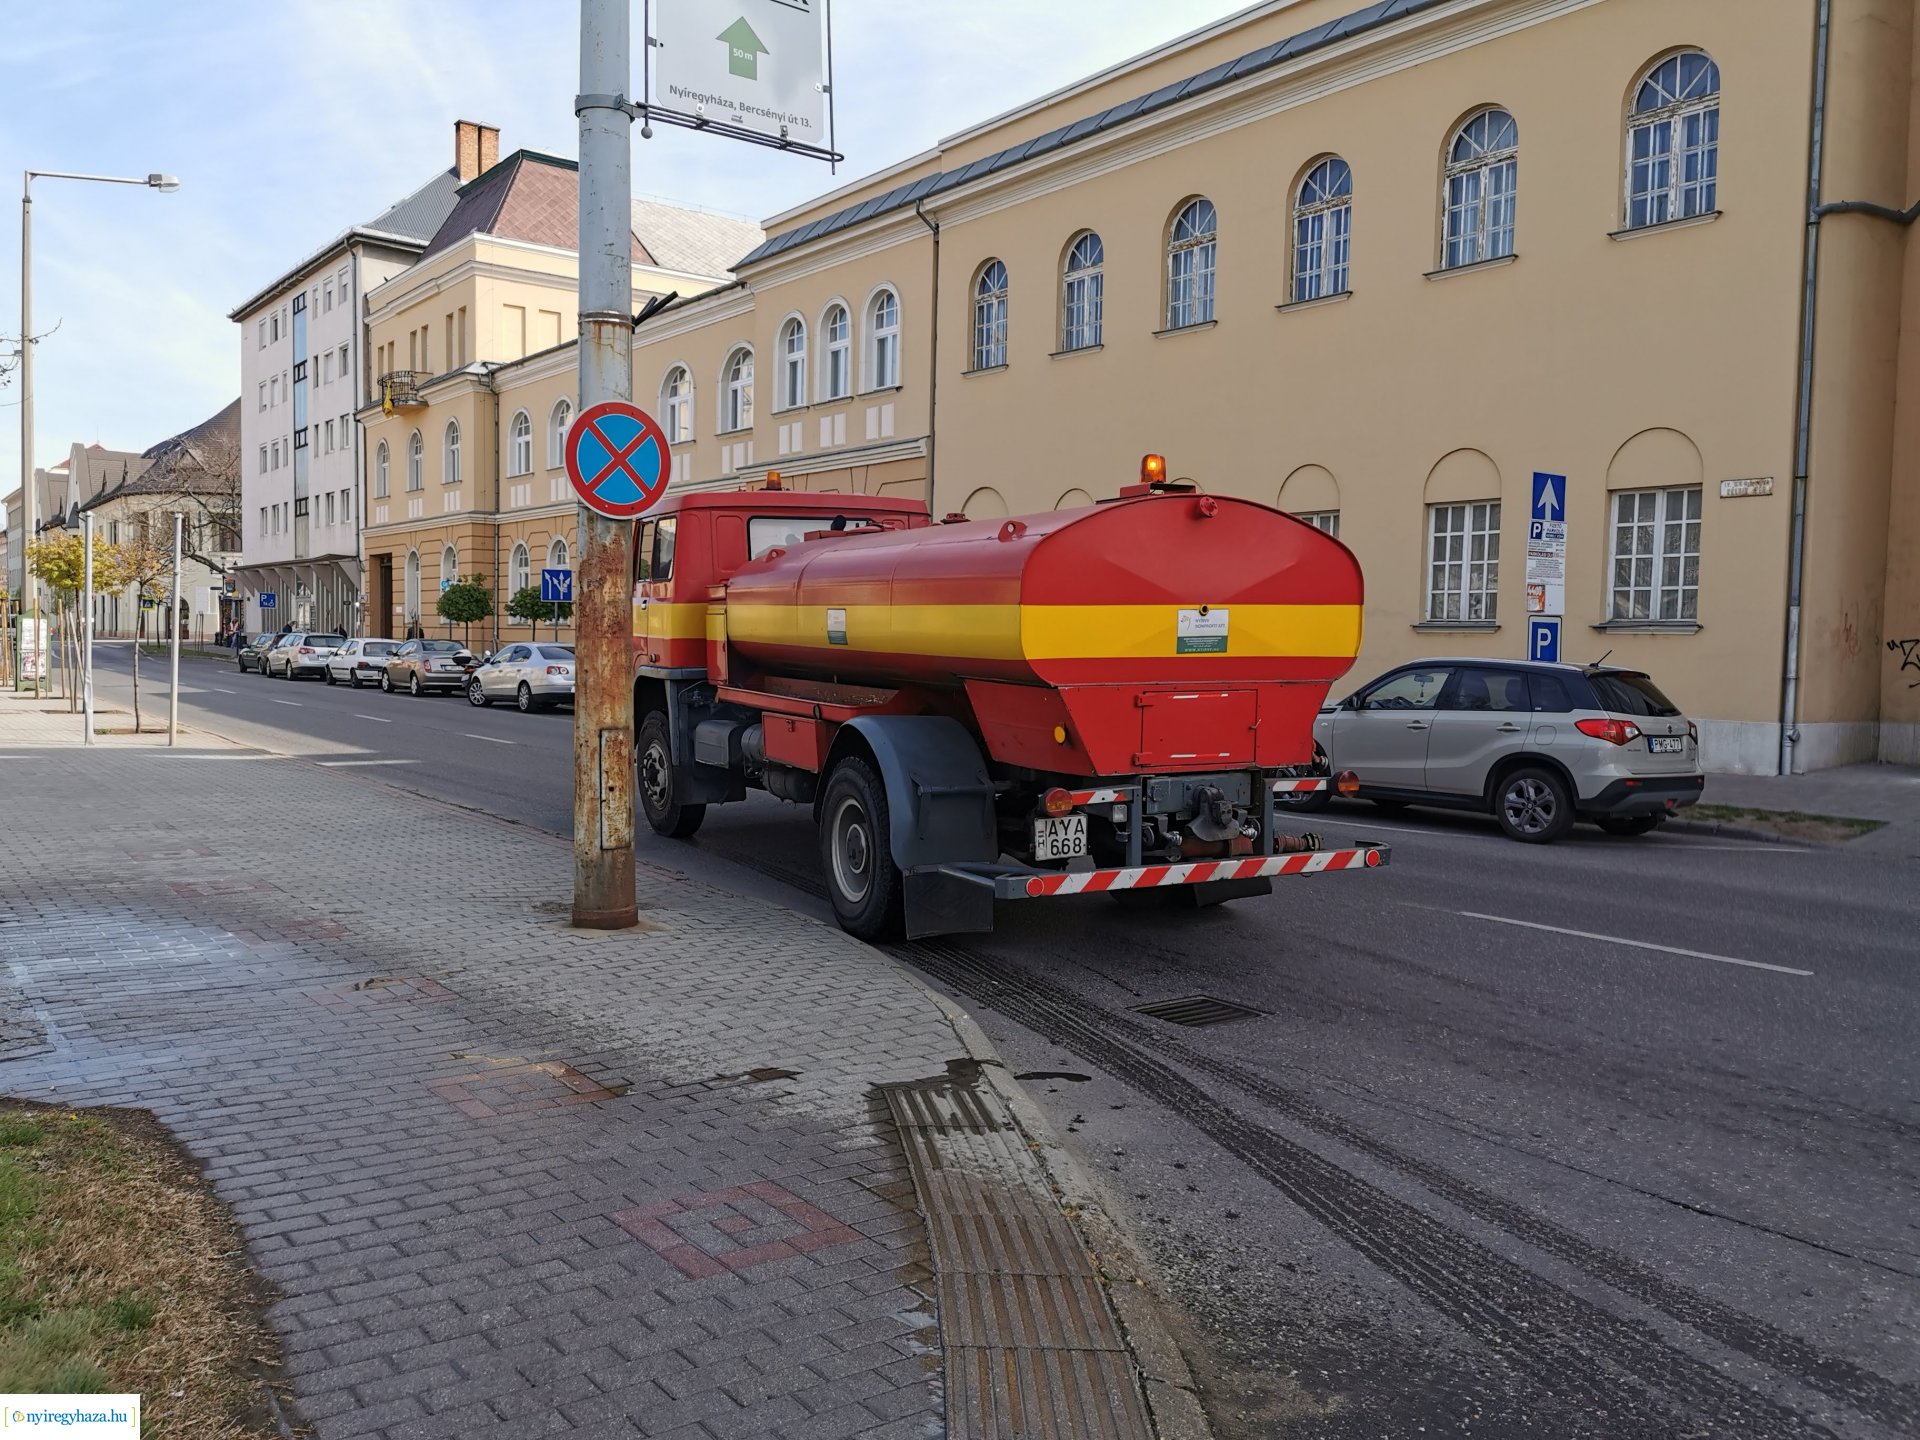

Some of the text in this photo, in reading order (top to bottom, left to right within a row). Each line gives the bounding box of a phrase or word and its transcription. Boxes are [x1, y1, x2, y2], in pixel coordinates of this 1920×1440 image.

[733, 48, 753, 61] 50 m
[669, 84, 737, 111] Nyíregyháza,
[739, 101, 787, 123] Bercsényi
[788, 113, 799, 125] út
[799, 117, 812, 128] 13.
[1532, 522, 1542, 538] P
[1536, 628, 1552, 659] P
[1048, 818, 1085, 838] AYA
[1050, 837, 1082, 856] 668
